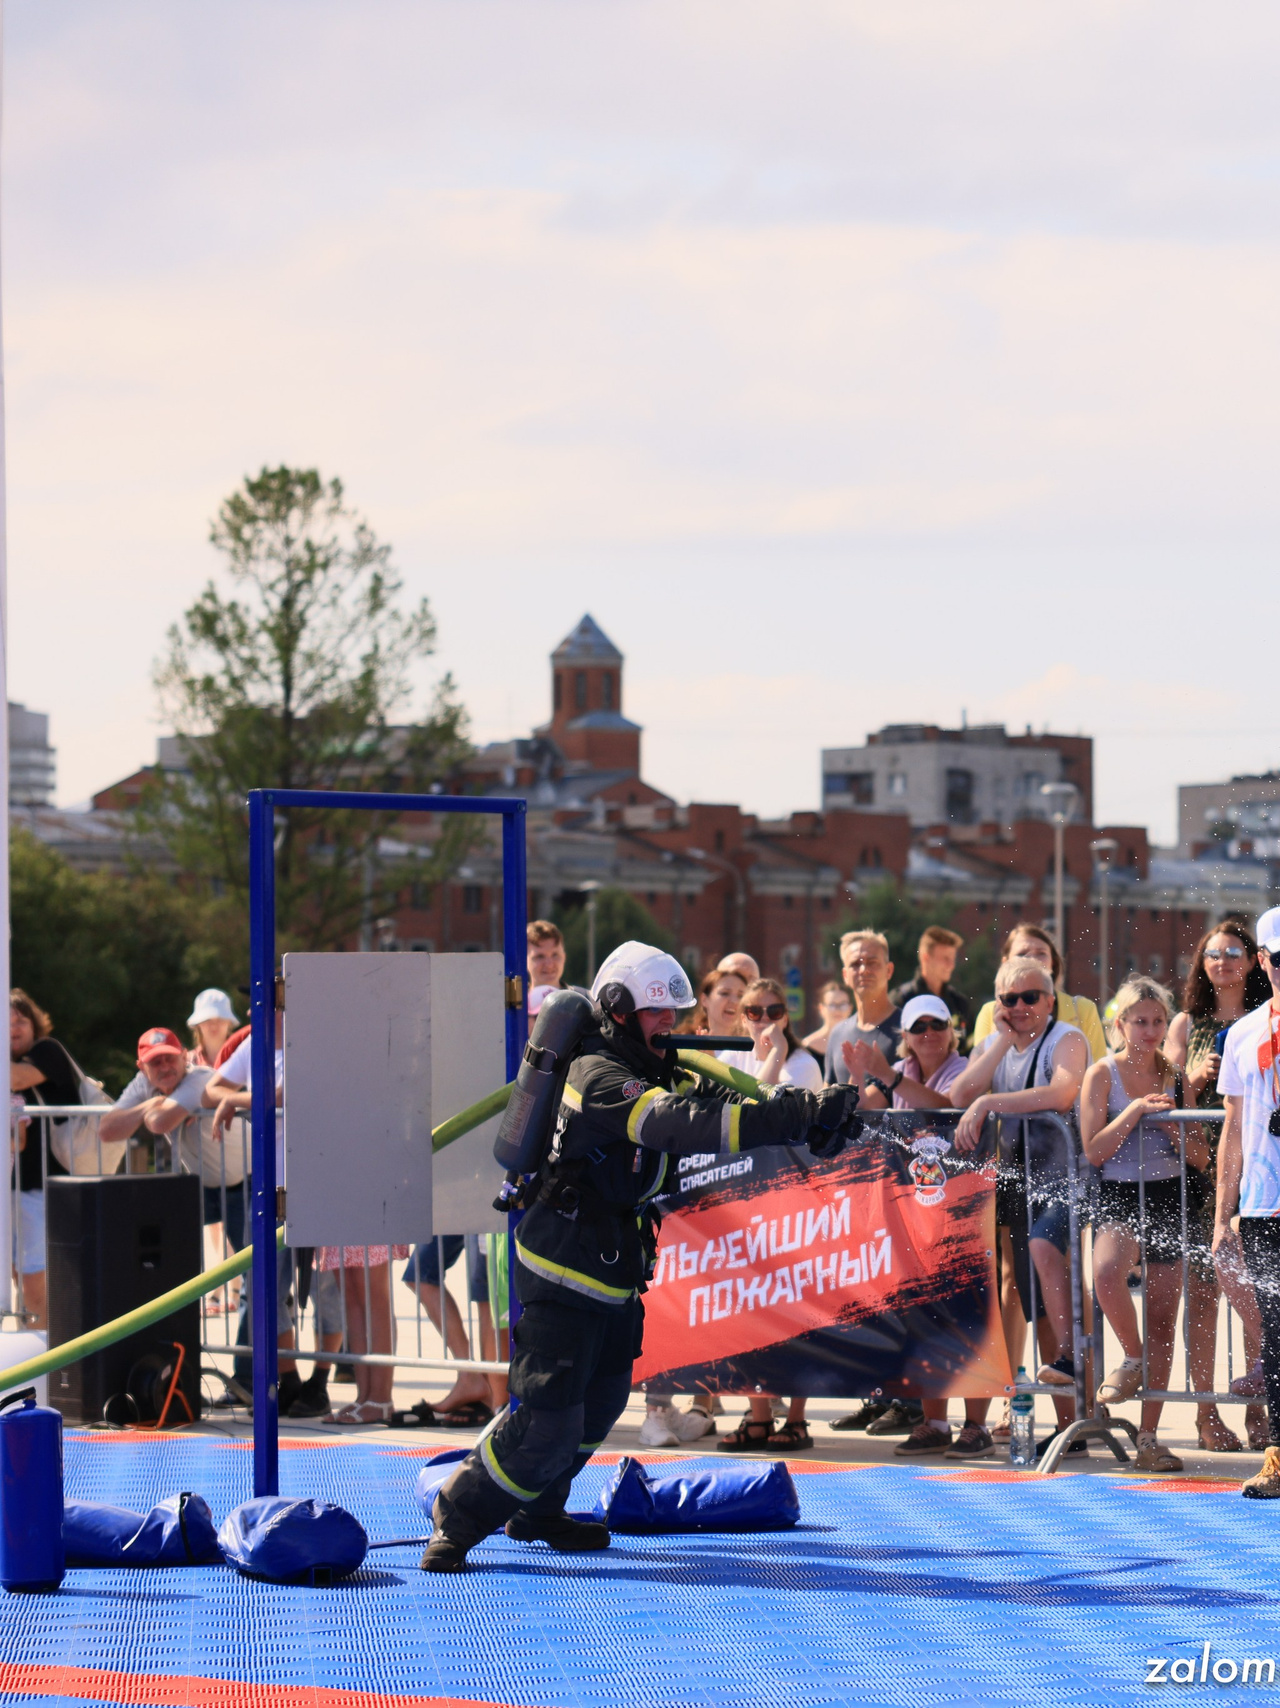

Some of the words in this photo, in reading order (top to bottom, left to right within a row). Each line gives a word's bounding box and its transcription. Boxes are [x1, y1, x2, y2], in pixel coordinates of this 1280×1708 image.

[649, 987, 664, 997] 35
[678, 1153, 716, 1173] СРЕДИ
[680, 1156, 754, 1192] СПАСАТЕЛЕЙ
[647, 1189, 852, 1288] ЛЬНЕЙШИЙ
[689, 1228, 893, 1328] ПОЖАРНЫЙ
